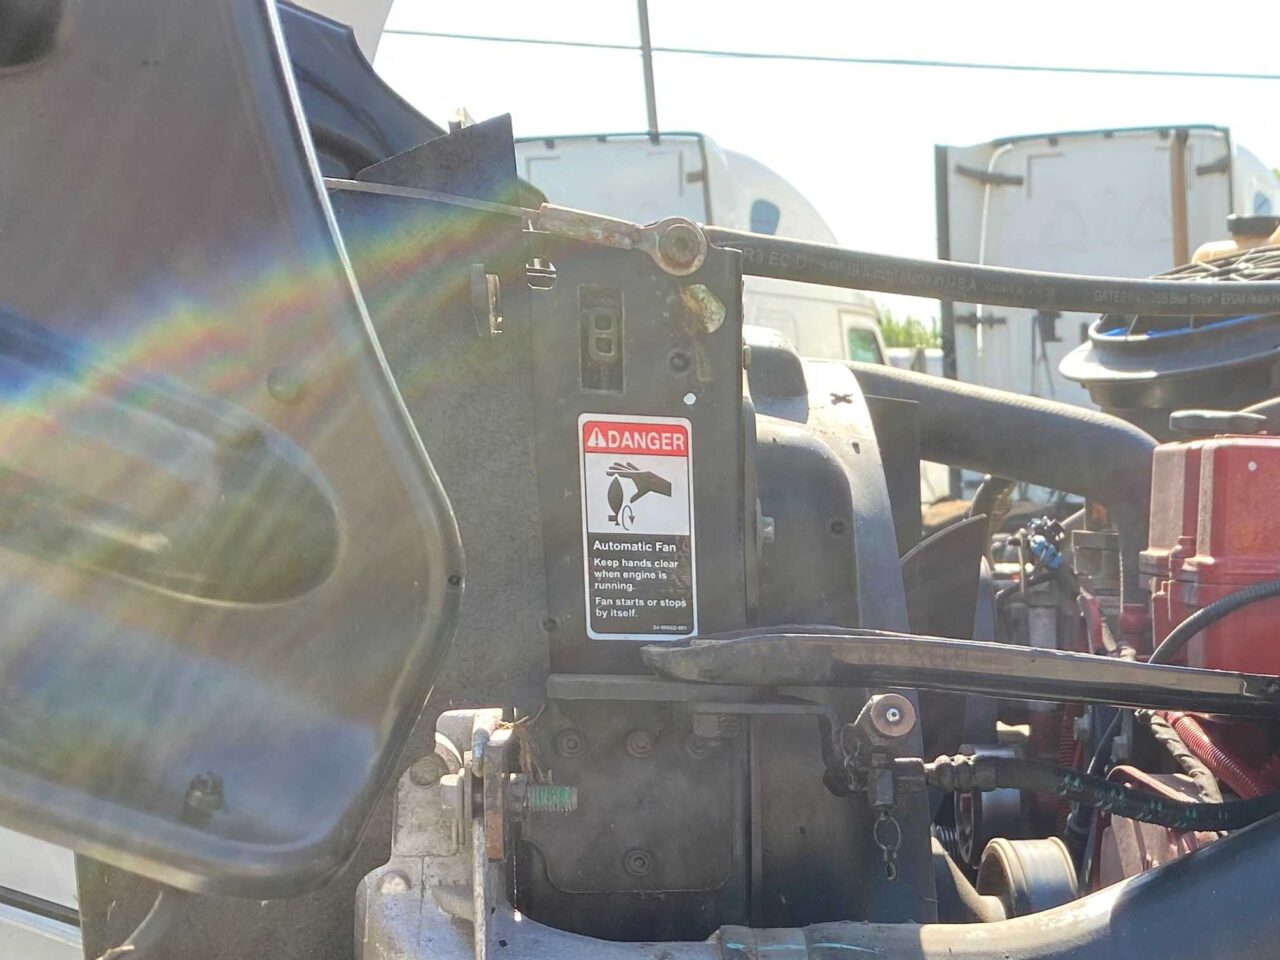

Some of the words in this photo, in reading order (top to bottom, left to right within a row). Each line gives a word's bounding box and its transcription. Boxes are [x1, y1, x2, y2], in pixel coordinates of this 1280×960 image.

[607, 430, 685, 451] DANGER
[593, 540, 652, 552] Automatic
[655, 542, 677, 552] Fan
[594, 558, 619, 568] Keep
[622, 559, 652, 568] hands
[654, 560, 679, 568] clear
[594, 570, 620, 579] when
[623, 571, 656, 580] engine
[658, 571, 667, 580] is
[594, 582, 636, 592] running.
[595, 597, 613, 606] Fan
[615, 598, 644, 606] starts
[647, 599, 657, 607] or
[659, 598, 687, 608] stops
[595, 608, 608, 619] by
[610, 609, 638, 618] itself.
